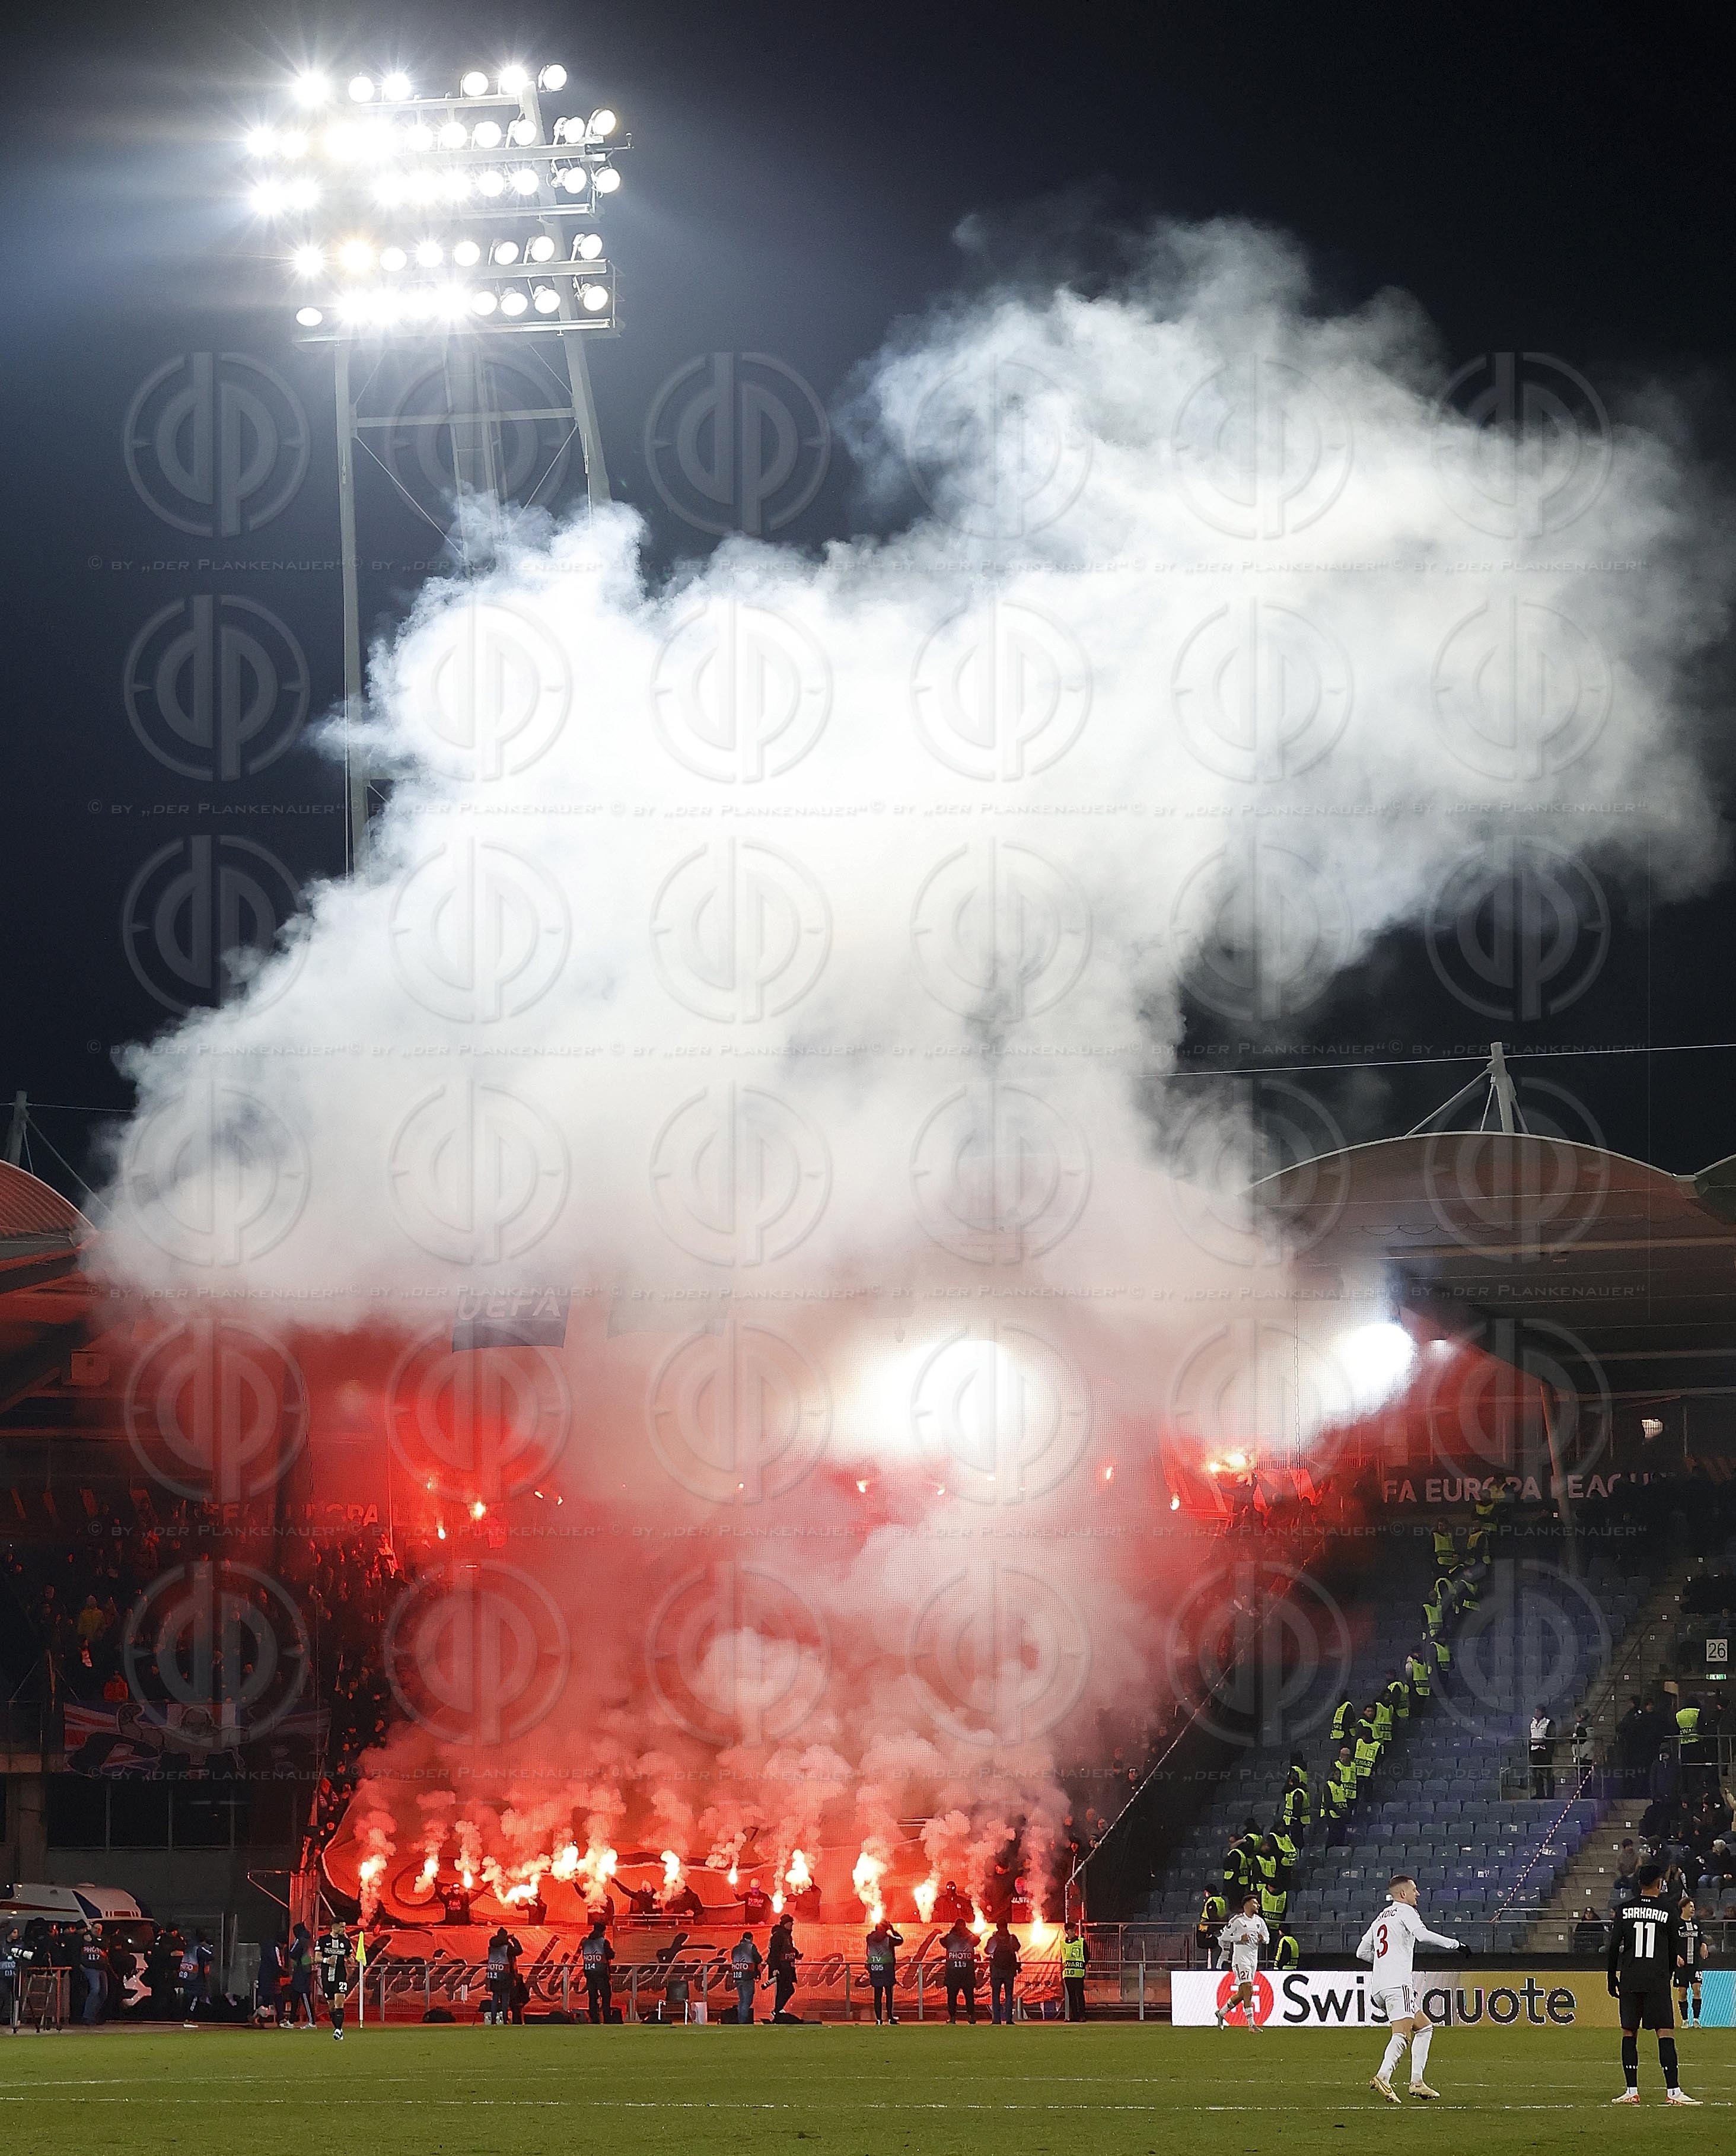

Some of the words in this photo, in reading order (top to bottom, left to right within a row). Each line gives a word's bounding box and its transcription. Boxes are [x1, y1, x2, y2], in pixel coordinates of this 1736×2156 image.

[1708, 1642, 1726, 1658] 26
[1622, 1907, 1669, 1923] SARKARIA
[1377, 1923, 1388, 1959] 3
[1633, 1921, 1656, 1958] 11
[1240, 1970, 1250, 1980] 27
